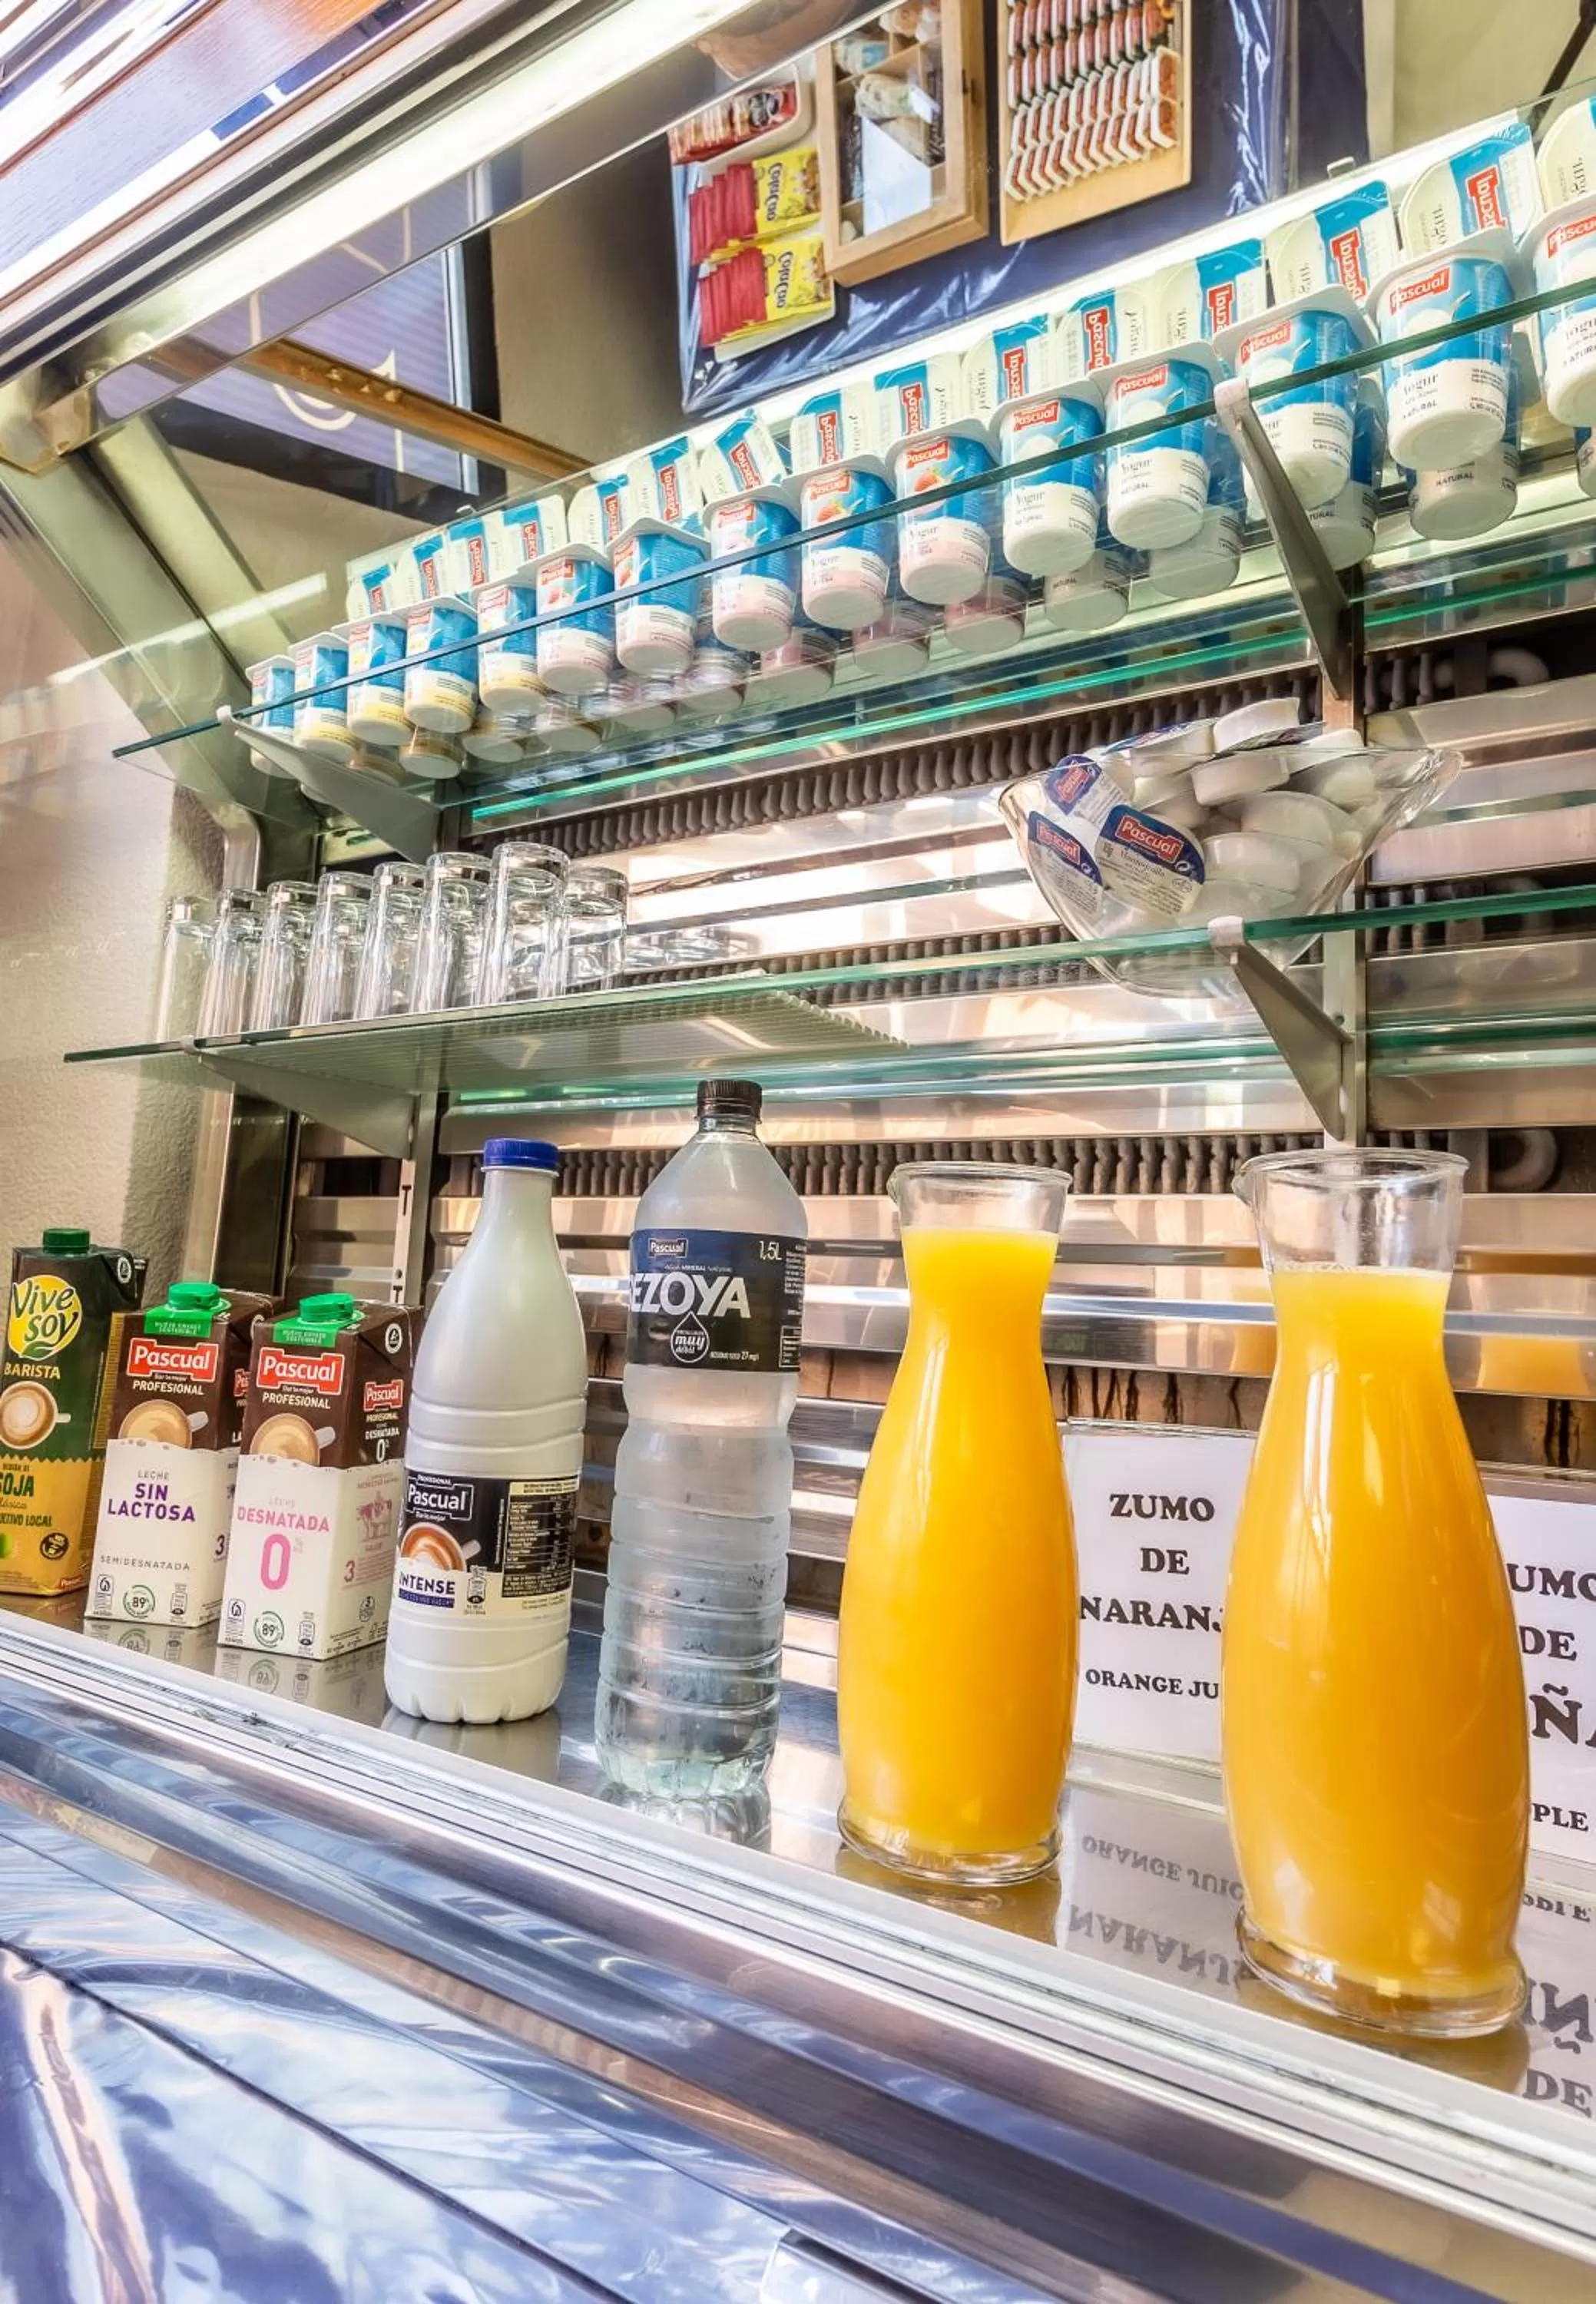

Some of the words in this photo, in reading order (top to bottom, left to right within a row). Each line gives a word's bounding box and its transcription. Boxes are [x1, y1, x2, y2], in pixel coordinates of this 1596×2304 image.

[1435, 472, 1474, 487] NATURAL
[1122, 820, 1177, 856] Pascual
[650, 1240, 684, 1253] Pascual
[12, 1279, 75, 1319] Vive
[630, 1271, 751, 1319] EZOYA
[675, 1335, 706, 1350] muy
[134, 1345, 211, 1370] Pascual
[263, 1356, 336, 1382] Pascual
[5, 1362, 61, 1380] BARISTA
[133, 1380, 205, 1396] PROFESIONAL
[366, 1387, 399, 1402] Pascual
[263, 1392, 332, 1410] PROFESIONAL
[134, 1482, 169, 1501] SIN
[408, 1483, 466, 1511] Pascual
[107, 1498, 196, 1522] LACTOSA
[236, 1505, 331, 1533] DESNATADA
[1109, 1493, 1215, 1522] ZUMO
[100, 1554, 191, 1571] SEMIDESNATADA
[1140, 1546, 1190, 1575] DE
[1507, 1562, 1596, 1602] UMO
[1520, 1624, 1577, 1662] DE
[1085, 1668, 1184, 1696] ORANGE
